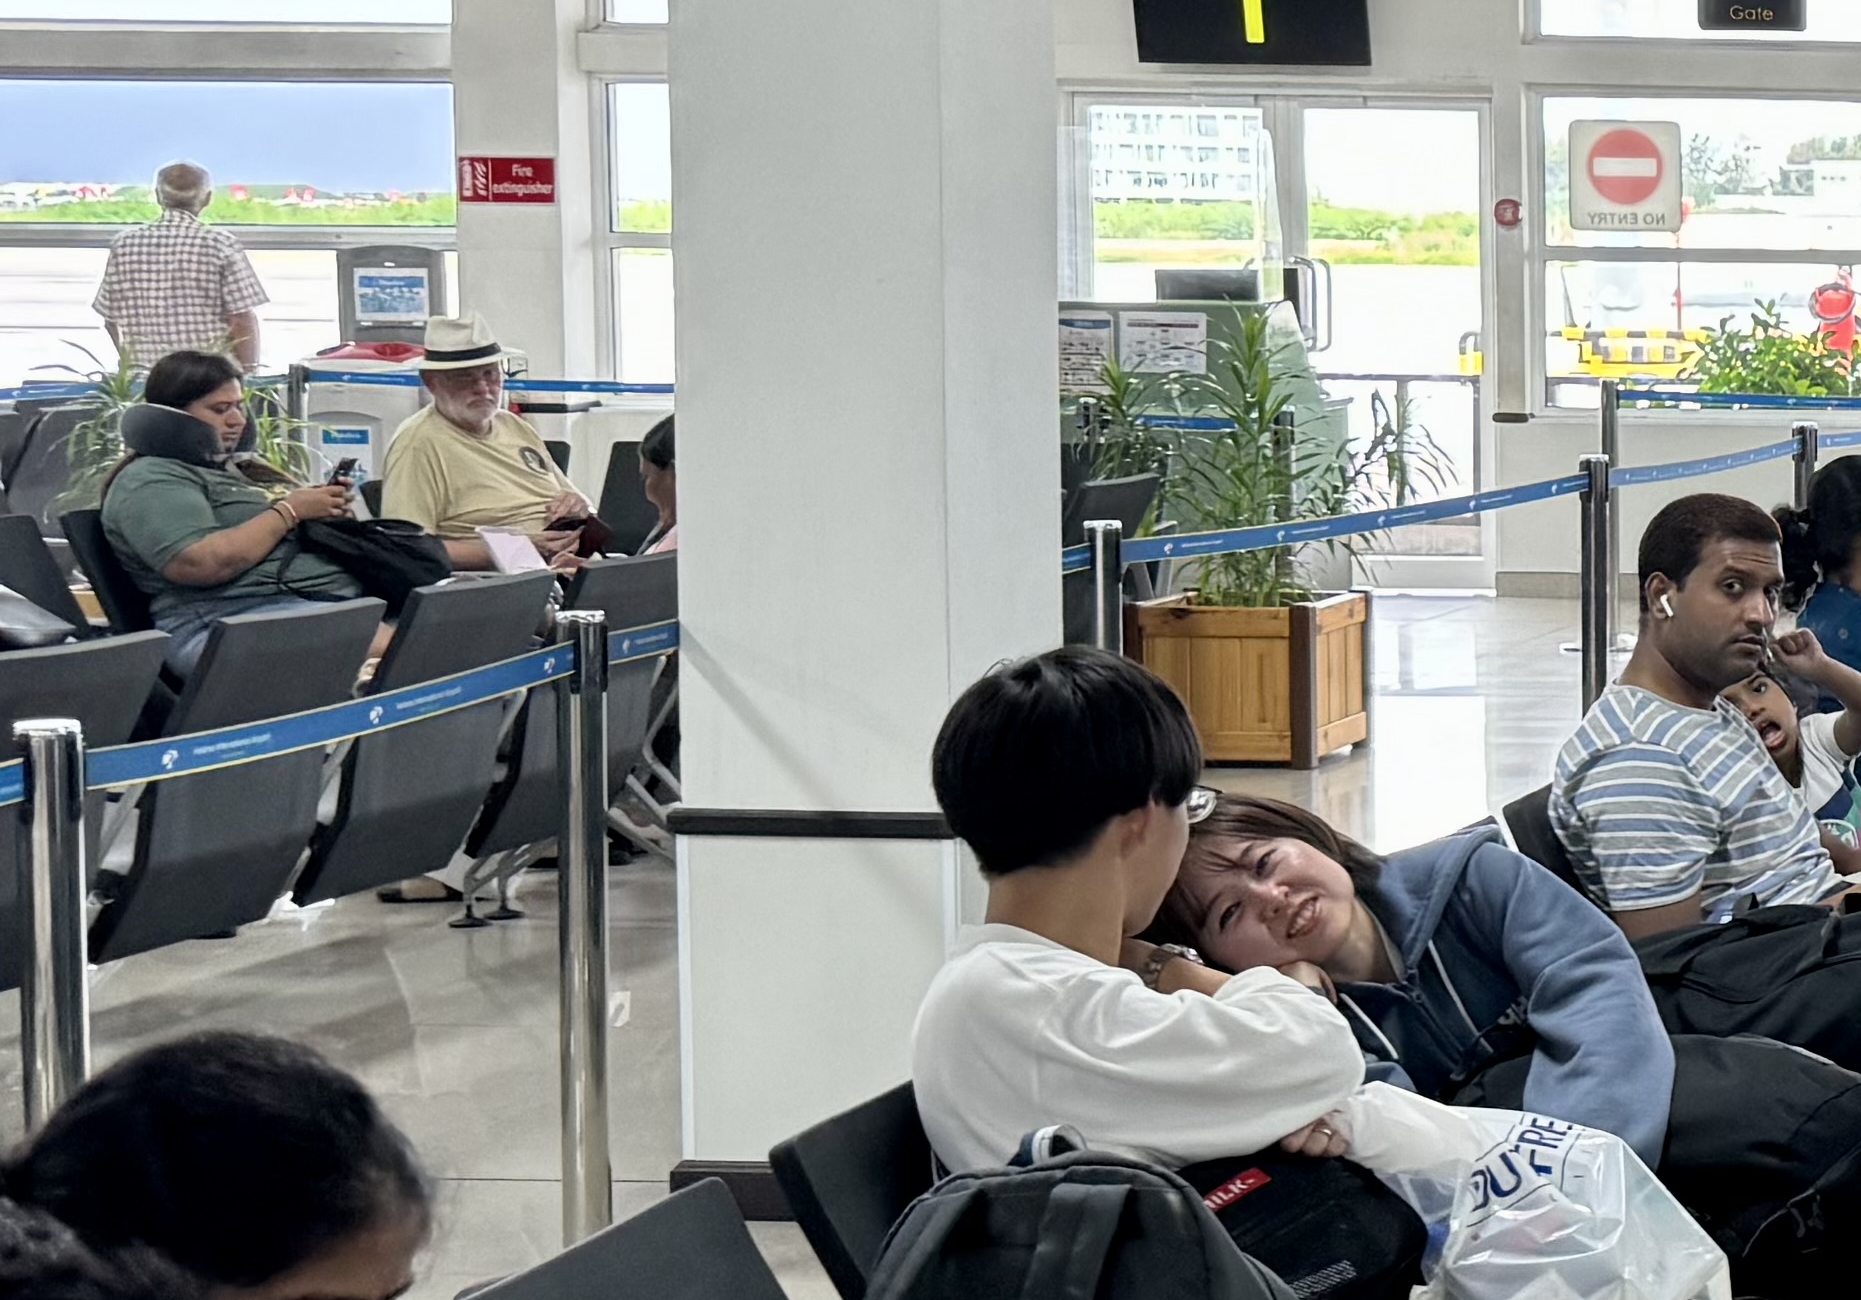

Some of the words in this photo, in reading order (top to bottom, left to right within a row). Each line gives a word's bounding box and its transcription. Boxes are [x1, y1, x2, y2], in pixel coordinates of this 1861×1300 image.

[1729, 5, 1774, 21] Gate
[511, 163, 534, 177] Fire
[492, 181, 553, 197] extinguisher
